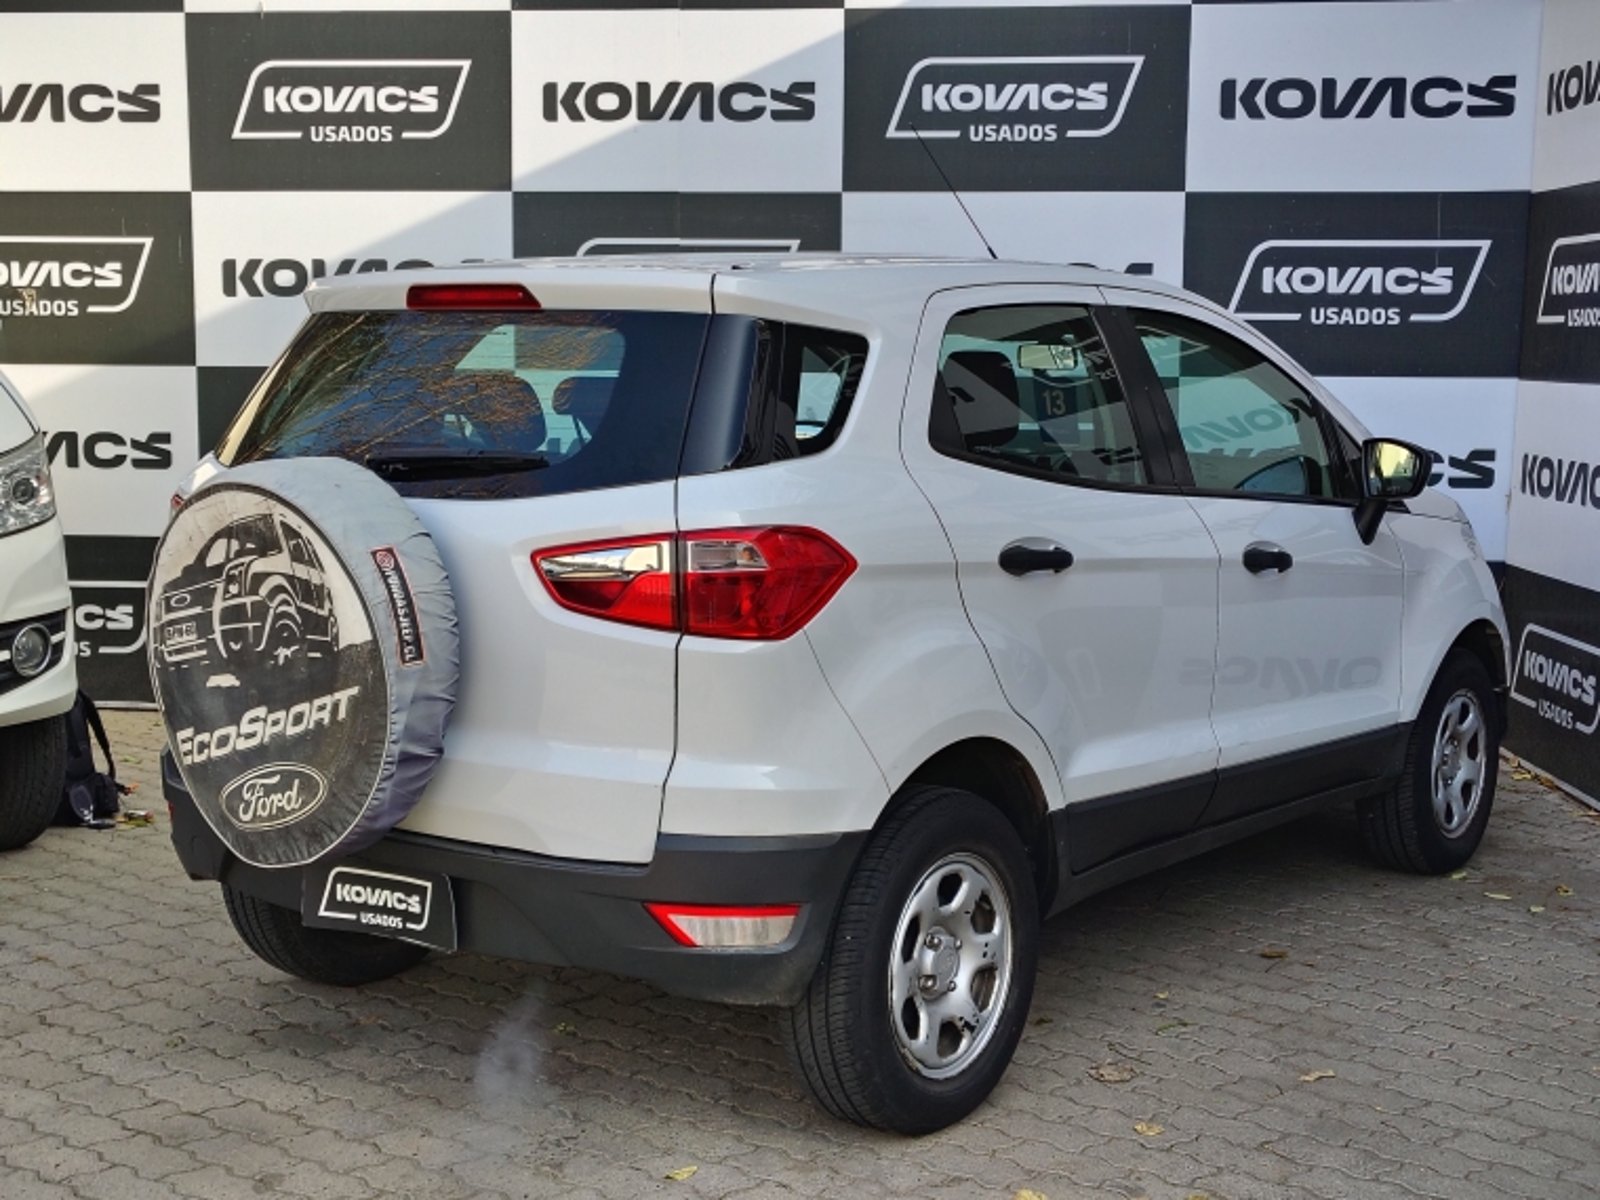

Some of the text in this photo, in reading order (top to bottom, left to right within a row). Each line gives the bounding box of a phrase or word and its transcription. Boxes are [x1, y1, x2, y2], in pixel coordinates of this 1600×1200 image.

[264, 85, 439, 114] KOVACS
[543, 81, 816, 123] KOVACS
[921, 82, 1108, 112] KOVACS
[1219, 75, 1517, 120] KOVACS
[1547, 60, 1600, 116] KOV
[310, 125, 393, 142] USADOS
[969, 124, 1058, 142] USADOS
[1262, 266, 1454, 294] KOVACS
[1311, 307, 1401, 325] USADOS
[1042, 388, 1066, 416] 13
[42, 431, 172, 470] ACS
[1523, 650, 1598, 706] KOVACS
[1537, 703, 1574, 730] USADOS
[239, 774, 302, 822] Ford
[336, 883, 421, 914] KOVACS
[359, 911, 403, 929] USADOS
